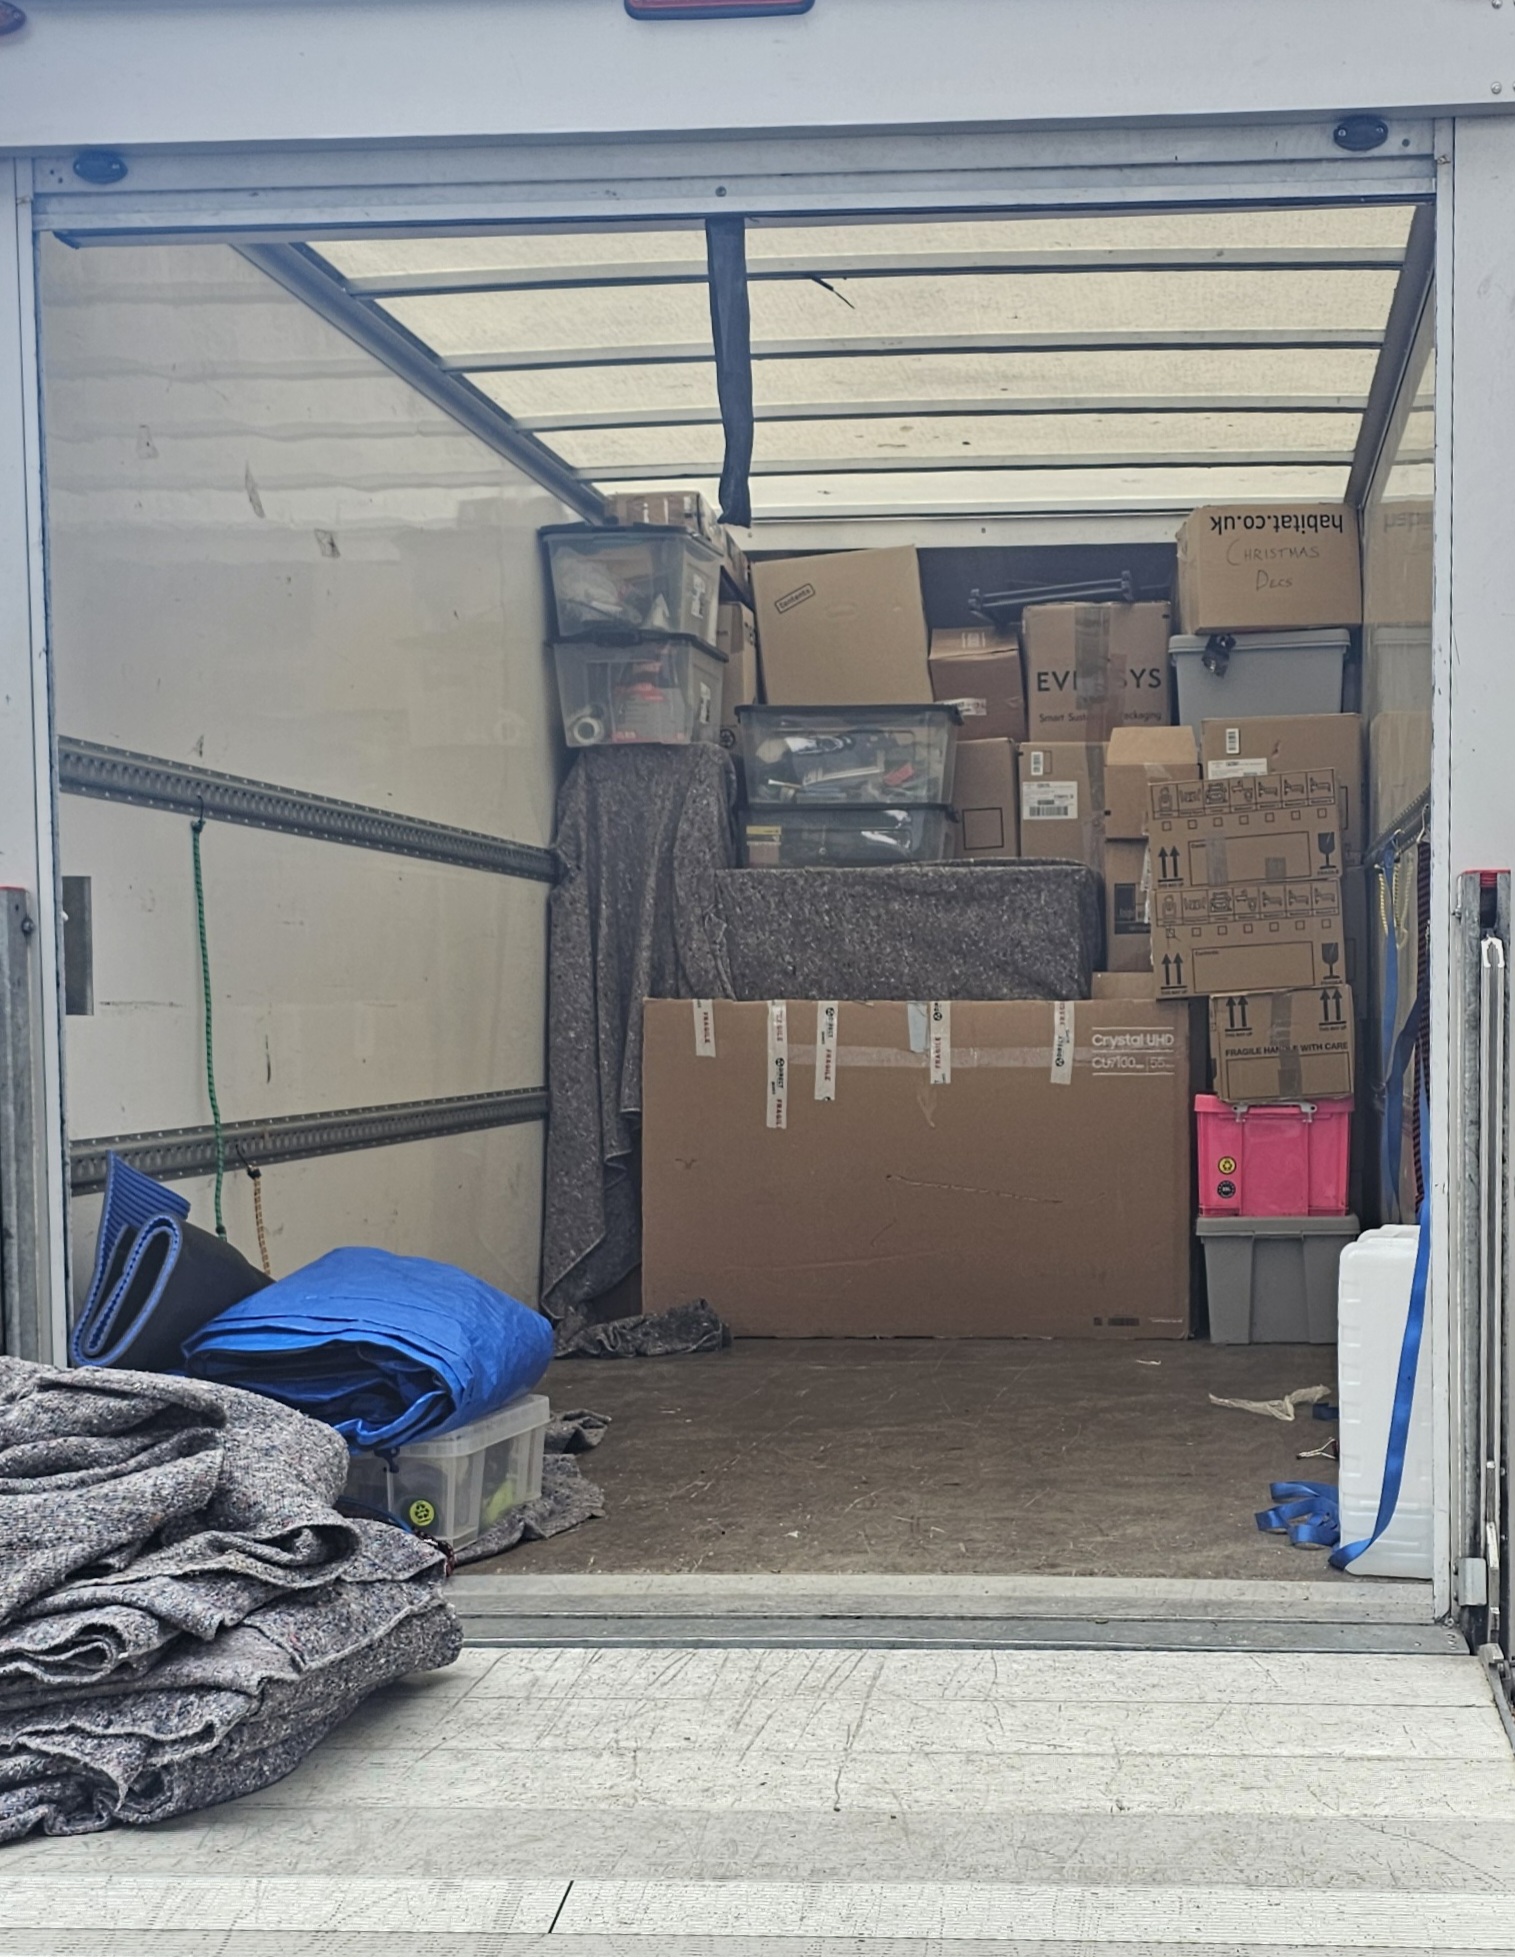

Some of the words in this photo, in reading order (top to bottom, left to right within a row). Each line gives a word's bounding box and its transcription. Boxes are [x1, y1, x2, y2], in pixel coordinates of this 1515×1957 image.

[1210, 514, 1343, 535] habitat.co.uk
[1226, 538, 1320, 566] CHRISTMAS
[1037, 668, 1162, 692] EVIYS
[703, 1011, 711, 1043] FRAGILE
[1092, 1033, 1144, 1049] Crystal
[1146, 1033, 1174, 1046] UHD
[1225, 1047, 1262, 1056] FRAGILE
[1300, 1042, 1323, 1052] WITH
[1324, 1041, 1348, 1050] CARE
[824, 1048, 832, 1082] FRAGILE
